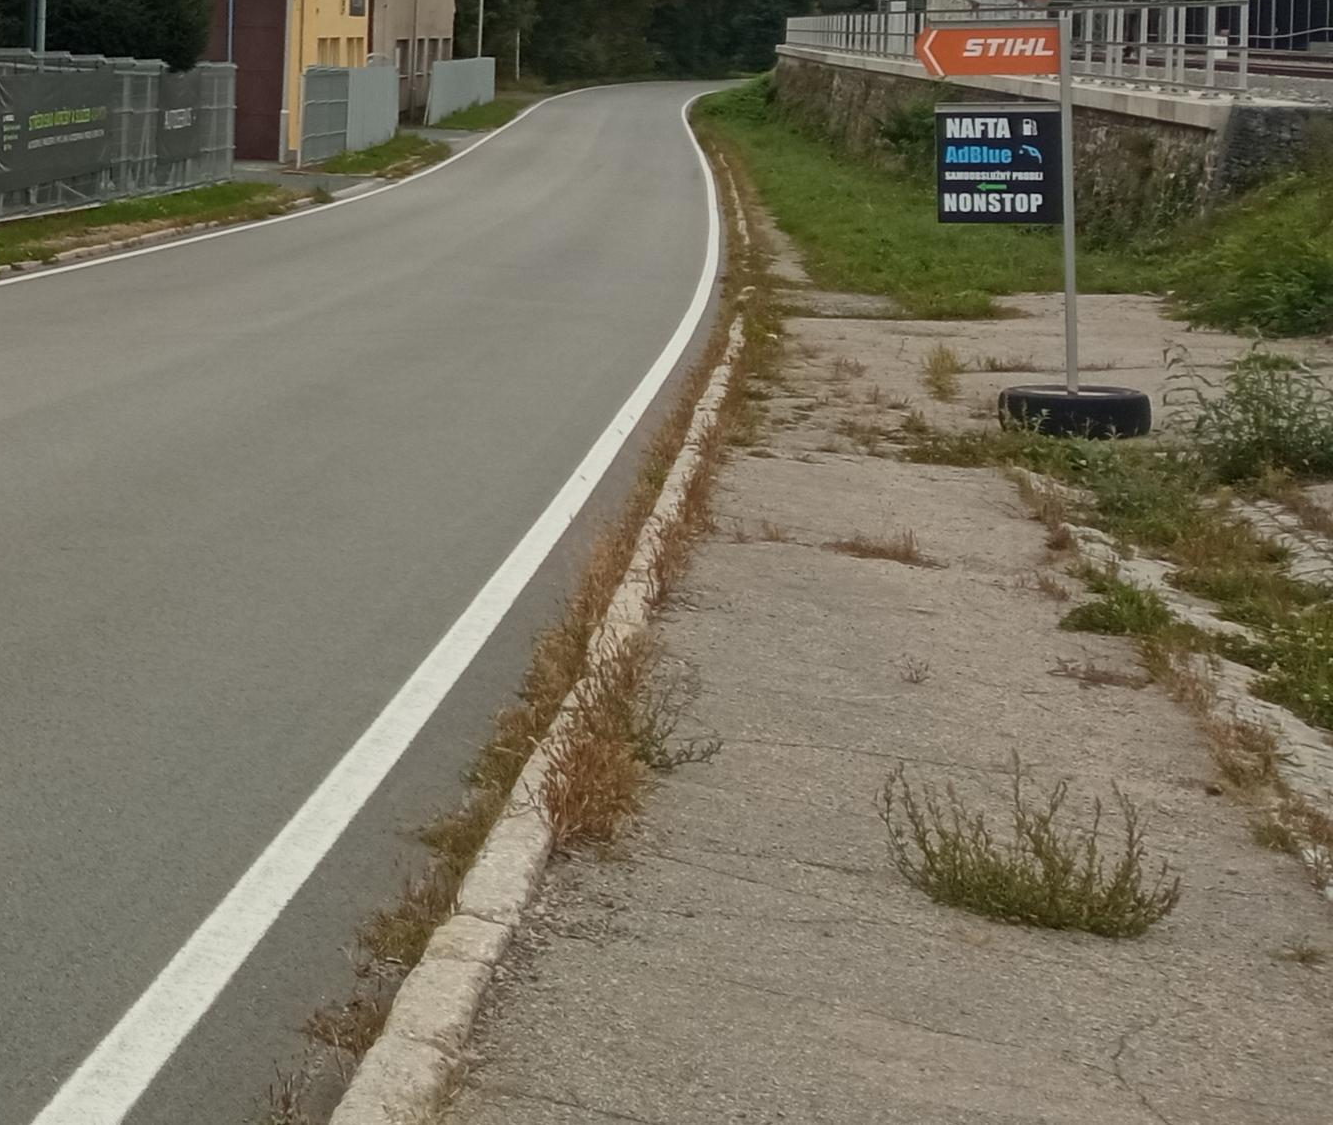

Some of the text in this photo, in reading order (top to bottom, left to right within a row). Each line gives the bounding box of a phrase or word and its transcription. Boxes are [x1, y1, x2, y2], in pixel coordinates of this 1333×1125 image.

[962, 38, 1054, 57] STIHL
[946, 118, 1011, 138] NAFTA
[945, 146, 1012, 163] AdBlue
[944, 193, 1043, 213] NONSTOP
